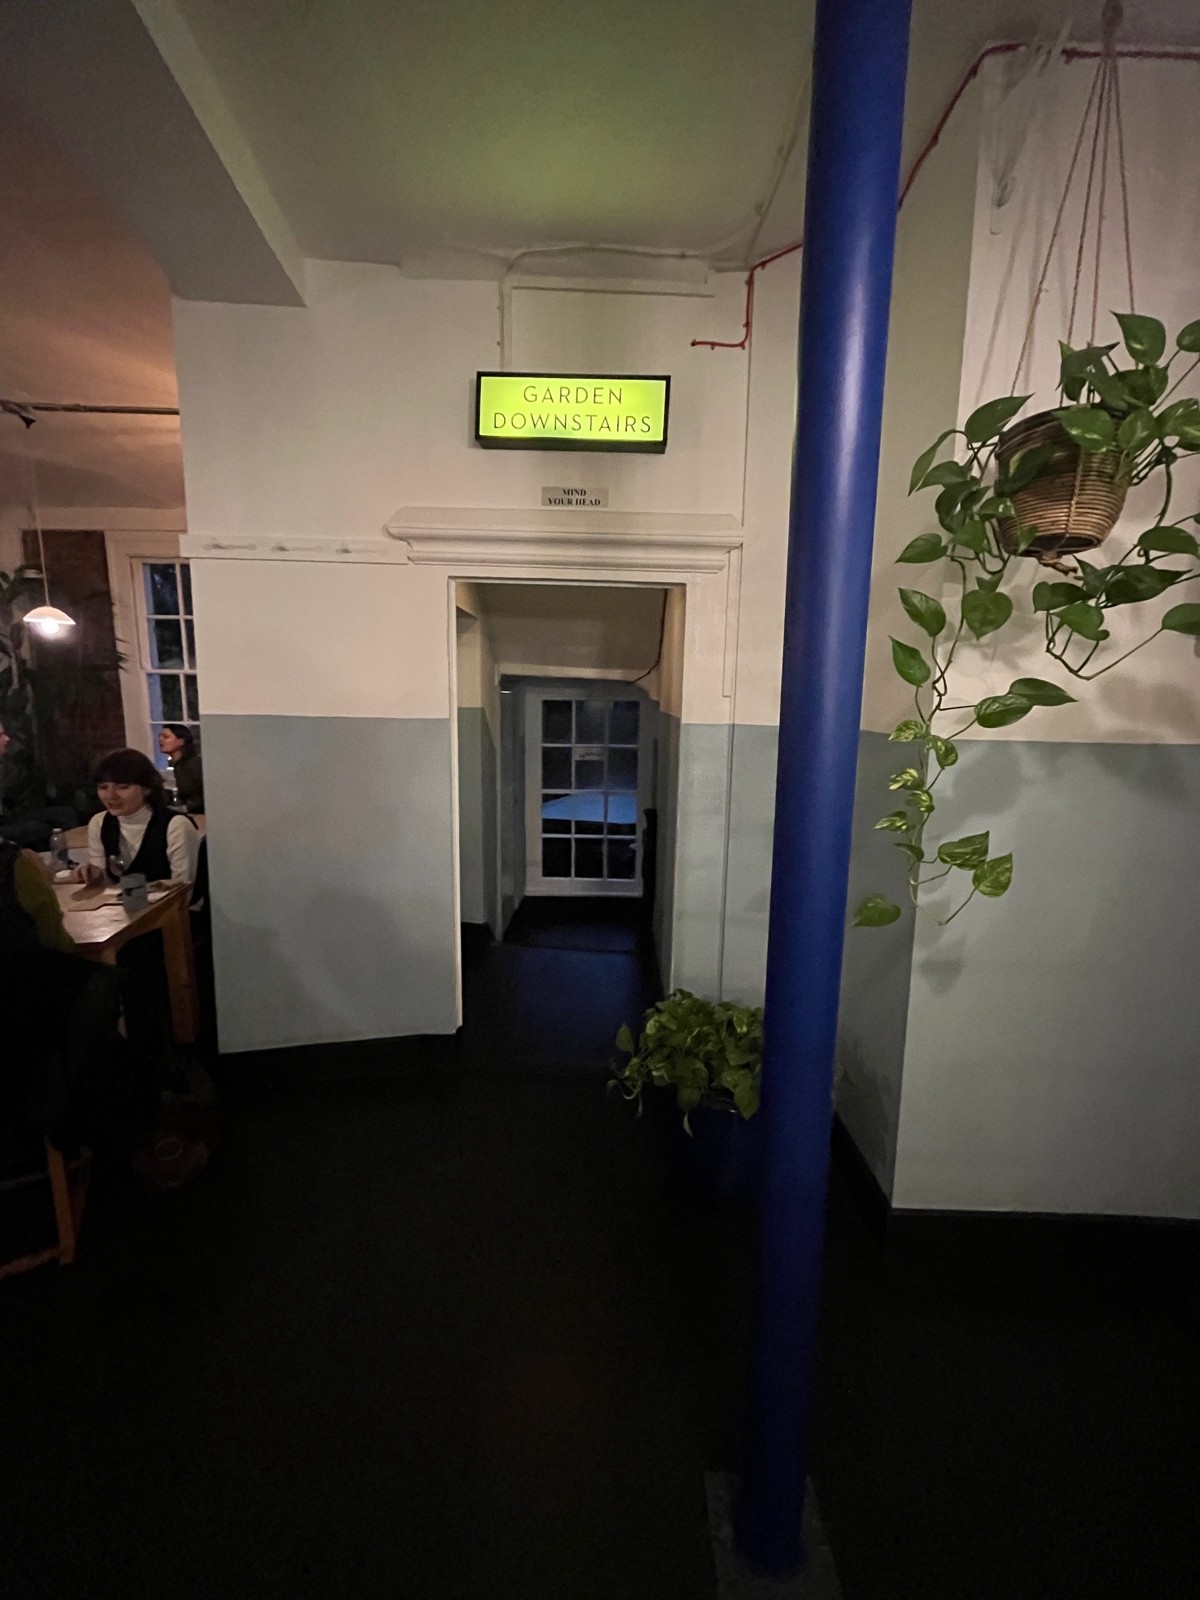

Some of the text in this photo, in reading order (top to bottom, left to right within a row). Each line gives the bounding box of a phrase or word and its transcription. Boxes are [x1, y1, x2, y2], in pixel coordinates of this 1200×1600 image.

[523, 385, 623, 404] GARDEN
[493, 412, 651, 433] DOWNSTAIRS
[562, 488, 587, 497] MIND
[547, 497, 601, 506] YOUR HEAD
